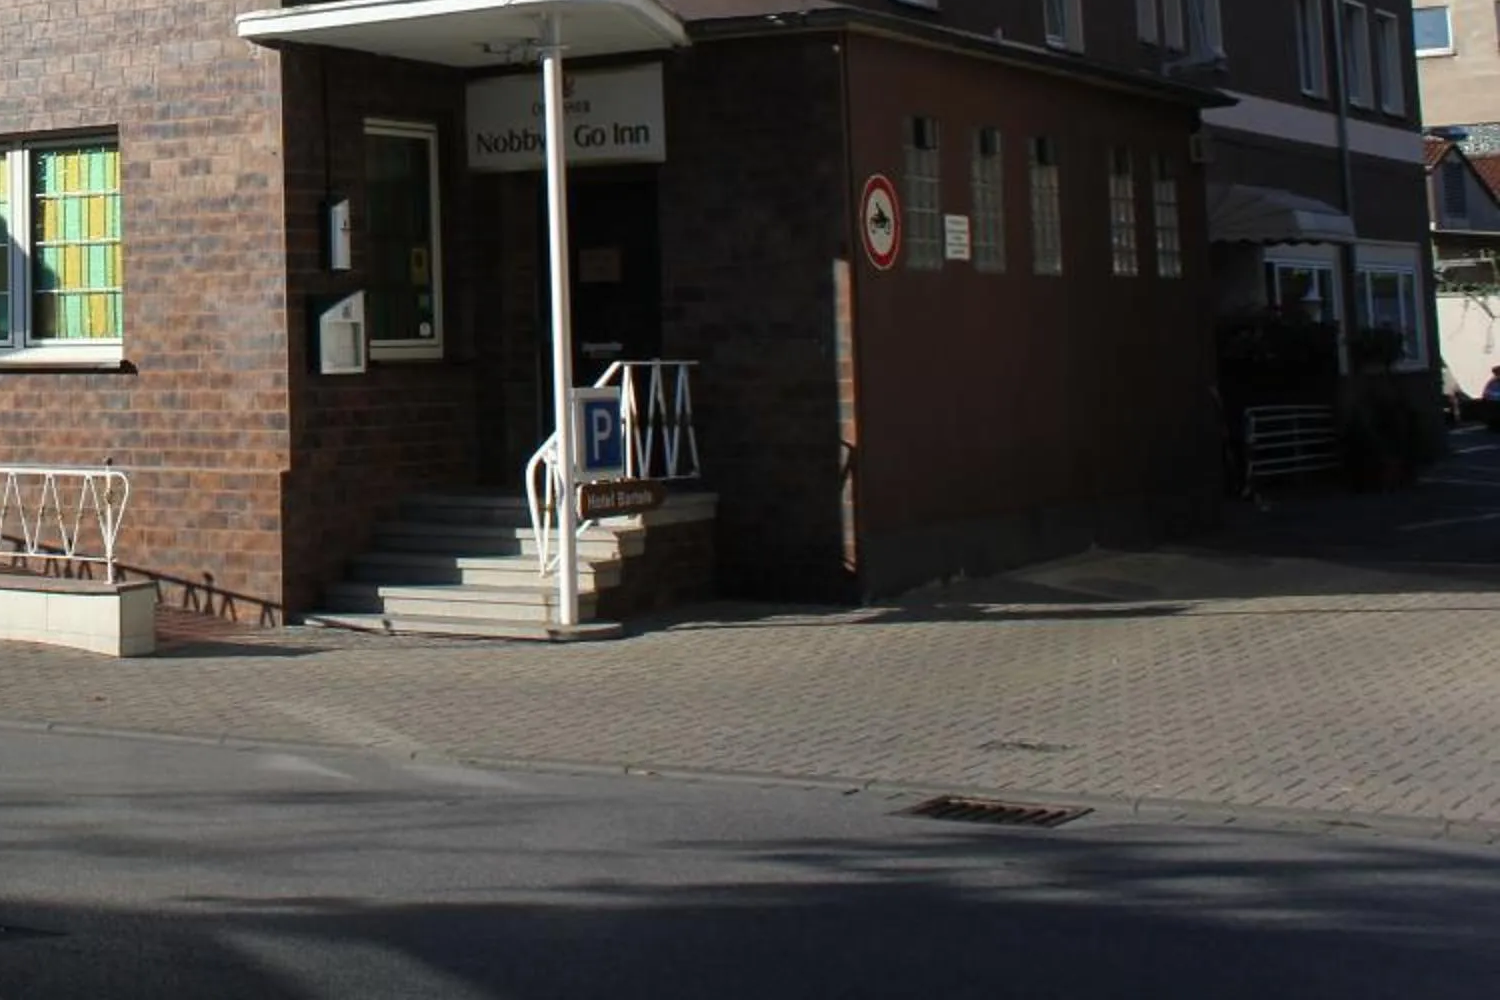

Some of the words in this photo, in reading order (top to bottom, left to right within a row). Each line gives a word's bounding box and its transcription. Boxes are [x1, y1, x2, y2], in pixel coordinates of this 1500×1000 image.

[574, 125, 606, 147] Go
[613, 123, 650, 145] Inn
[592, 408, 612, 460] P
